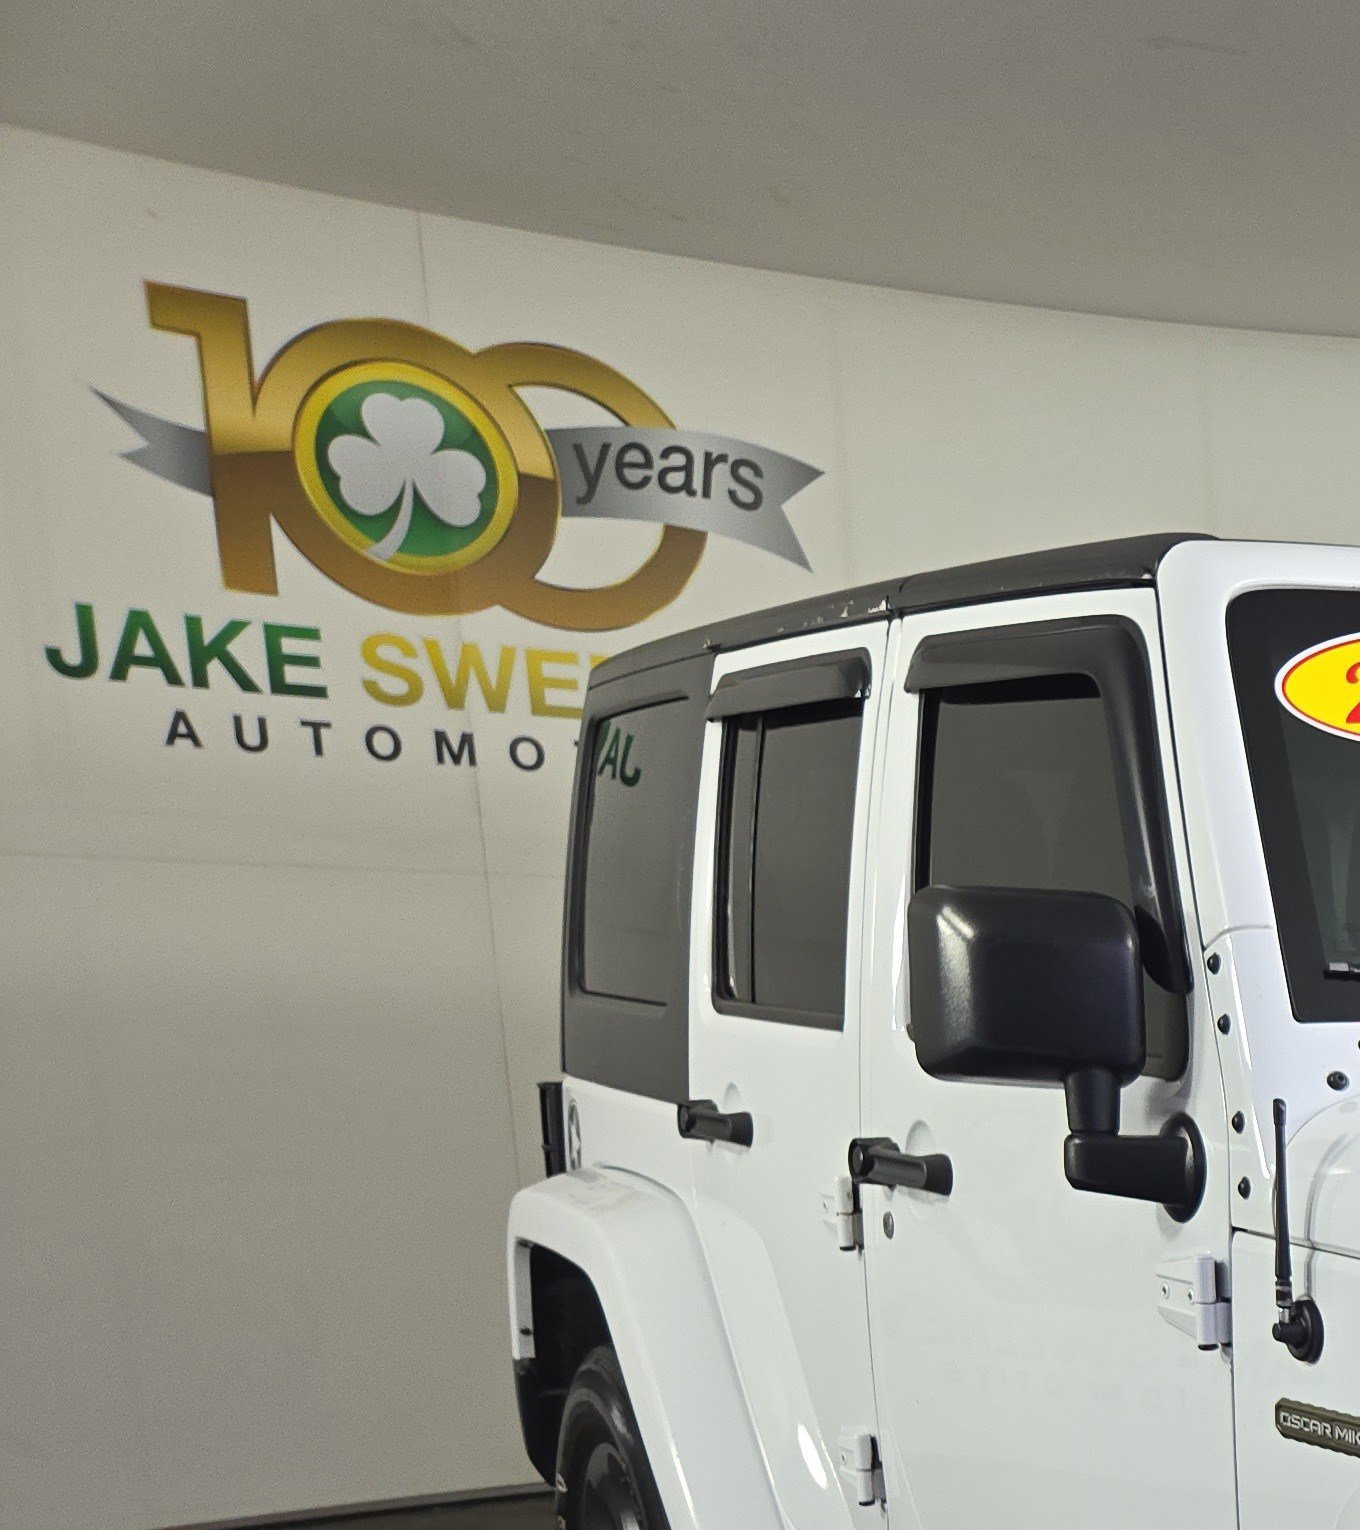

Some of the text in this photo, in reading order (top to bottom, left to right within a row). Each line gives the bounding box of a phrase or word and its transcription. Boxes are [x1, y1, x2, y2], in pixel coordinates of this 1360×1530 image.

[143, 280, 765, 632] 100 years
[44, 603, 329, 700] JAKE
[164, 709, 578, 772] AUTOMO
[1280, 1411, 1332, 1438] OSCAR
